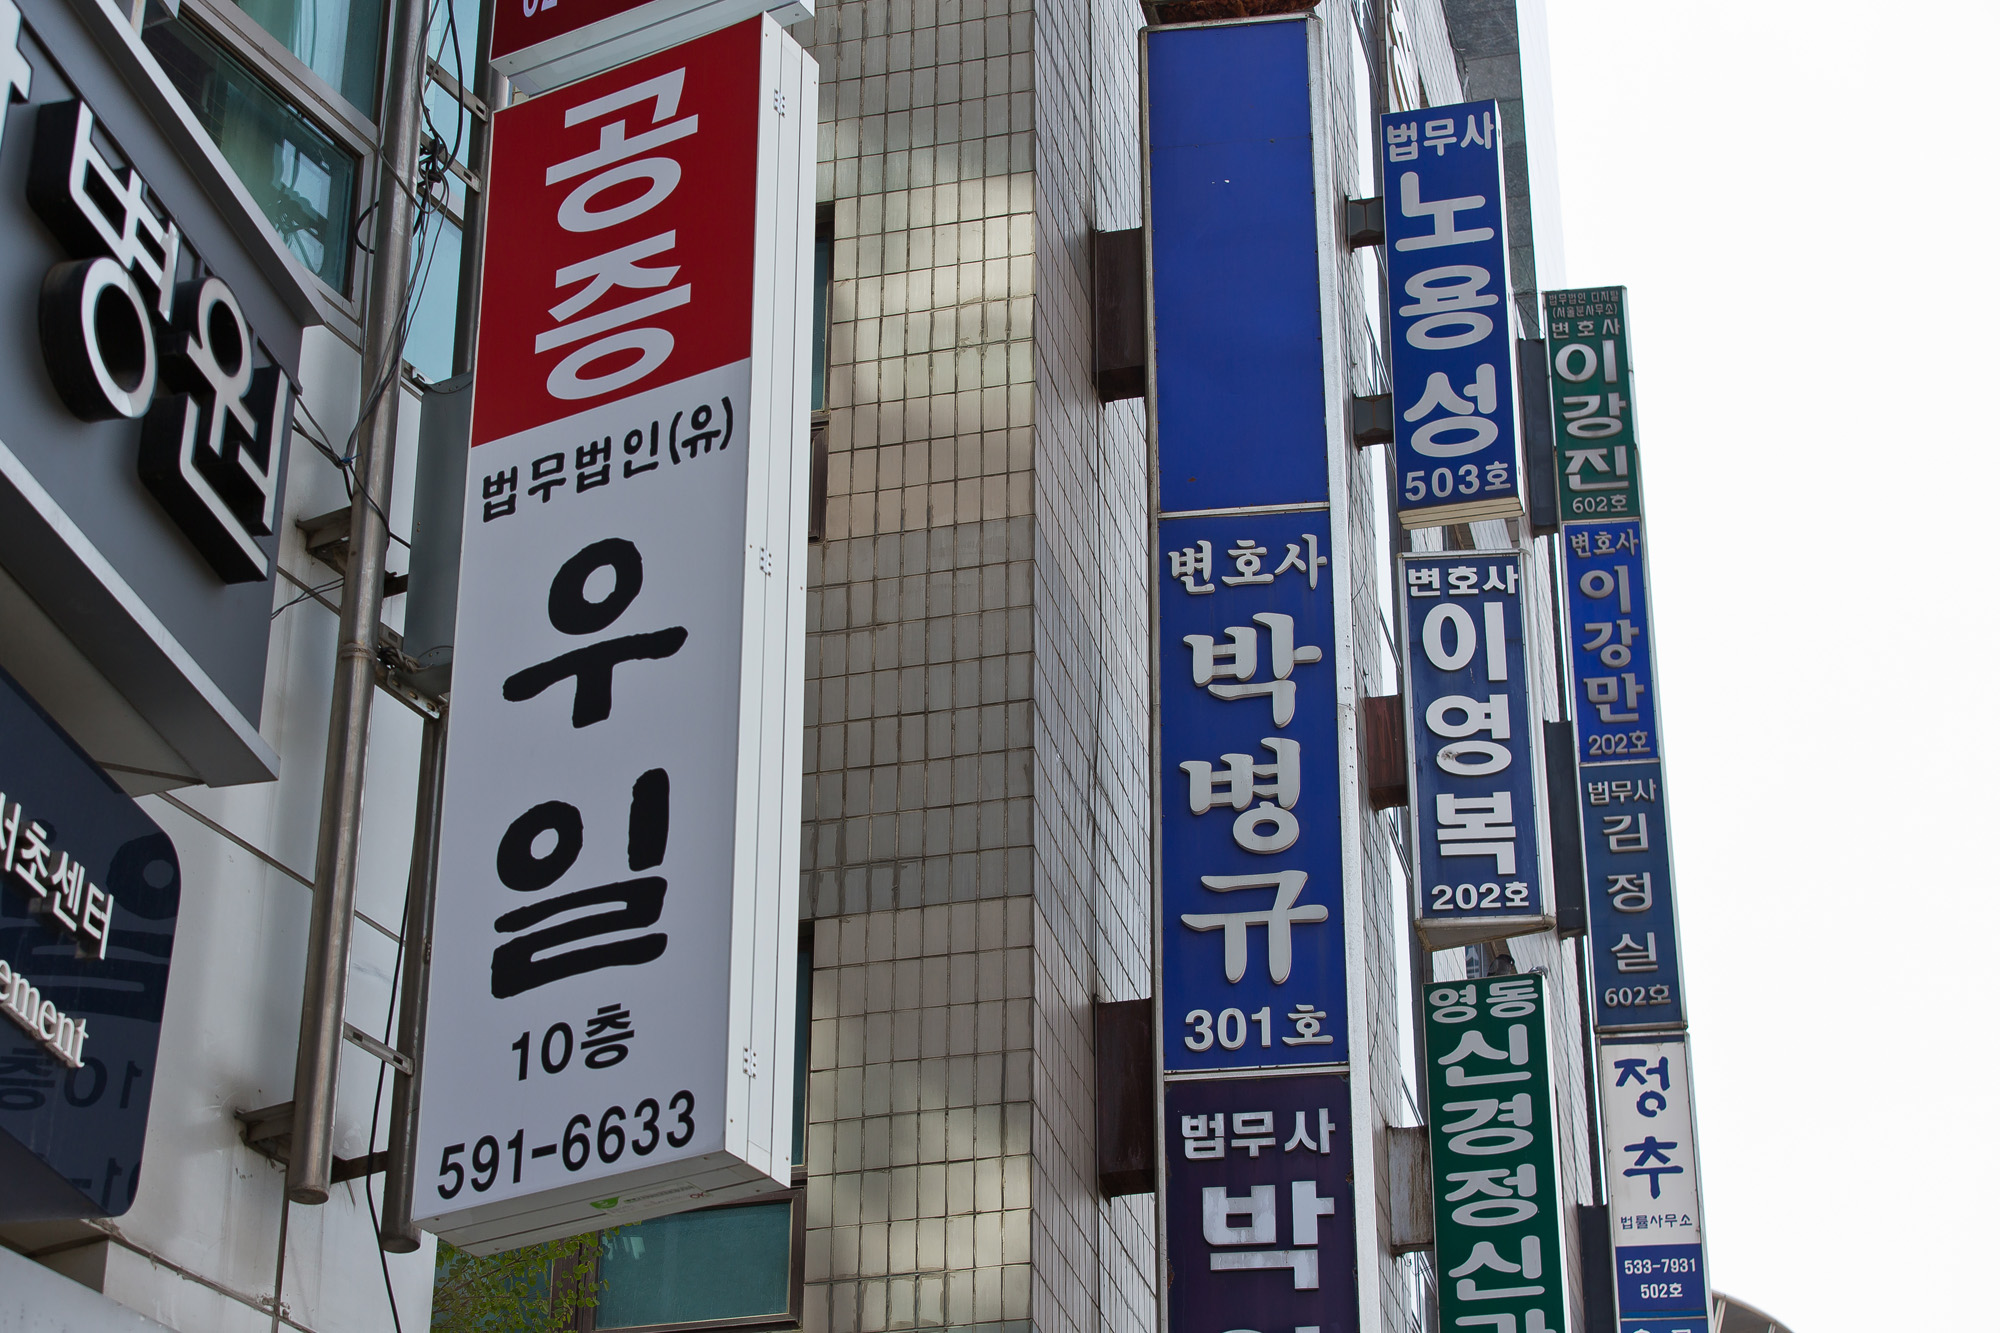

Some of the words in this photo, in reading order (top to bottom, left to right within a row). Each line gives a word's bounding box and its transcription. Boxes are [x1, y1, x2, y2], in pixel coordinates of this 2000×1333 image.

[1387, 111, 1495, 163] 법무사
[534, 66, 699, 401] 공증
[1395, 171, 1499, 458] 노용성
[1549, 291, 1586, 306] 법무법인
[1552, 318, 1621, 339] 변호사
[1555, 339, 1629, 492] 이강진
[482, 396, 735, 522] 법무법인(유)
[1405, 461, 1511, 501] 503호
[1572, 494, 1628, 514] 602호
[1168, 533, 1328, 596] 변호사
[1569, 528, 1639, 559] 변호사
[1408, 565, 1519, 597] 변호사
[1579, 565, 1645, 724] 이강만
[1421, 601, 1517, 876] 이영복
[1588, 730, 1650, 756] 202호
[490, 537, 689, 1000] 우일
[1588, 778, 1657, 806] 법무사
[1180, 611, 1330, 985] 박병규
[1431, 881, 1530, 911] 202호
[1602, 812, 1659, 973] 김정실
[1429, 979, 1539, 1024] 영동
[1604, 983, 1672, 1008] 602호
[510, 1003, 636, 1083] 10층
[1184, 1003, 1334, 1053] 301호
[436, 1089, 696, 1202] 591-6633
[1182, 1107, 1336, 1161] 법무사
[1613, 1055, 1684, 1200] 정추
[1620, 1213, 1693, 1230] 법률사무소
[1202, 1180, 1335, 1333] 박
[1624, 1257, 1696, 1275] 533-7931
[1640, 1282, 1683, 1299] 502호
